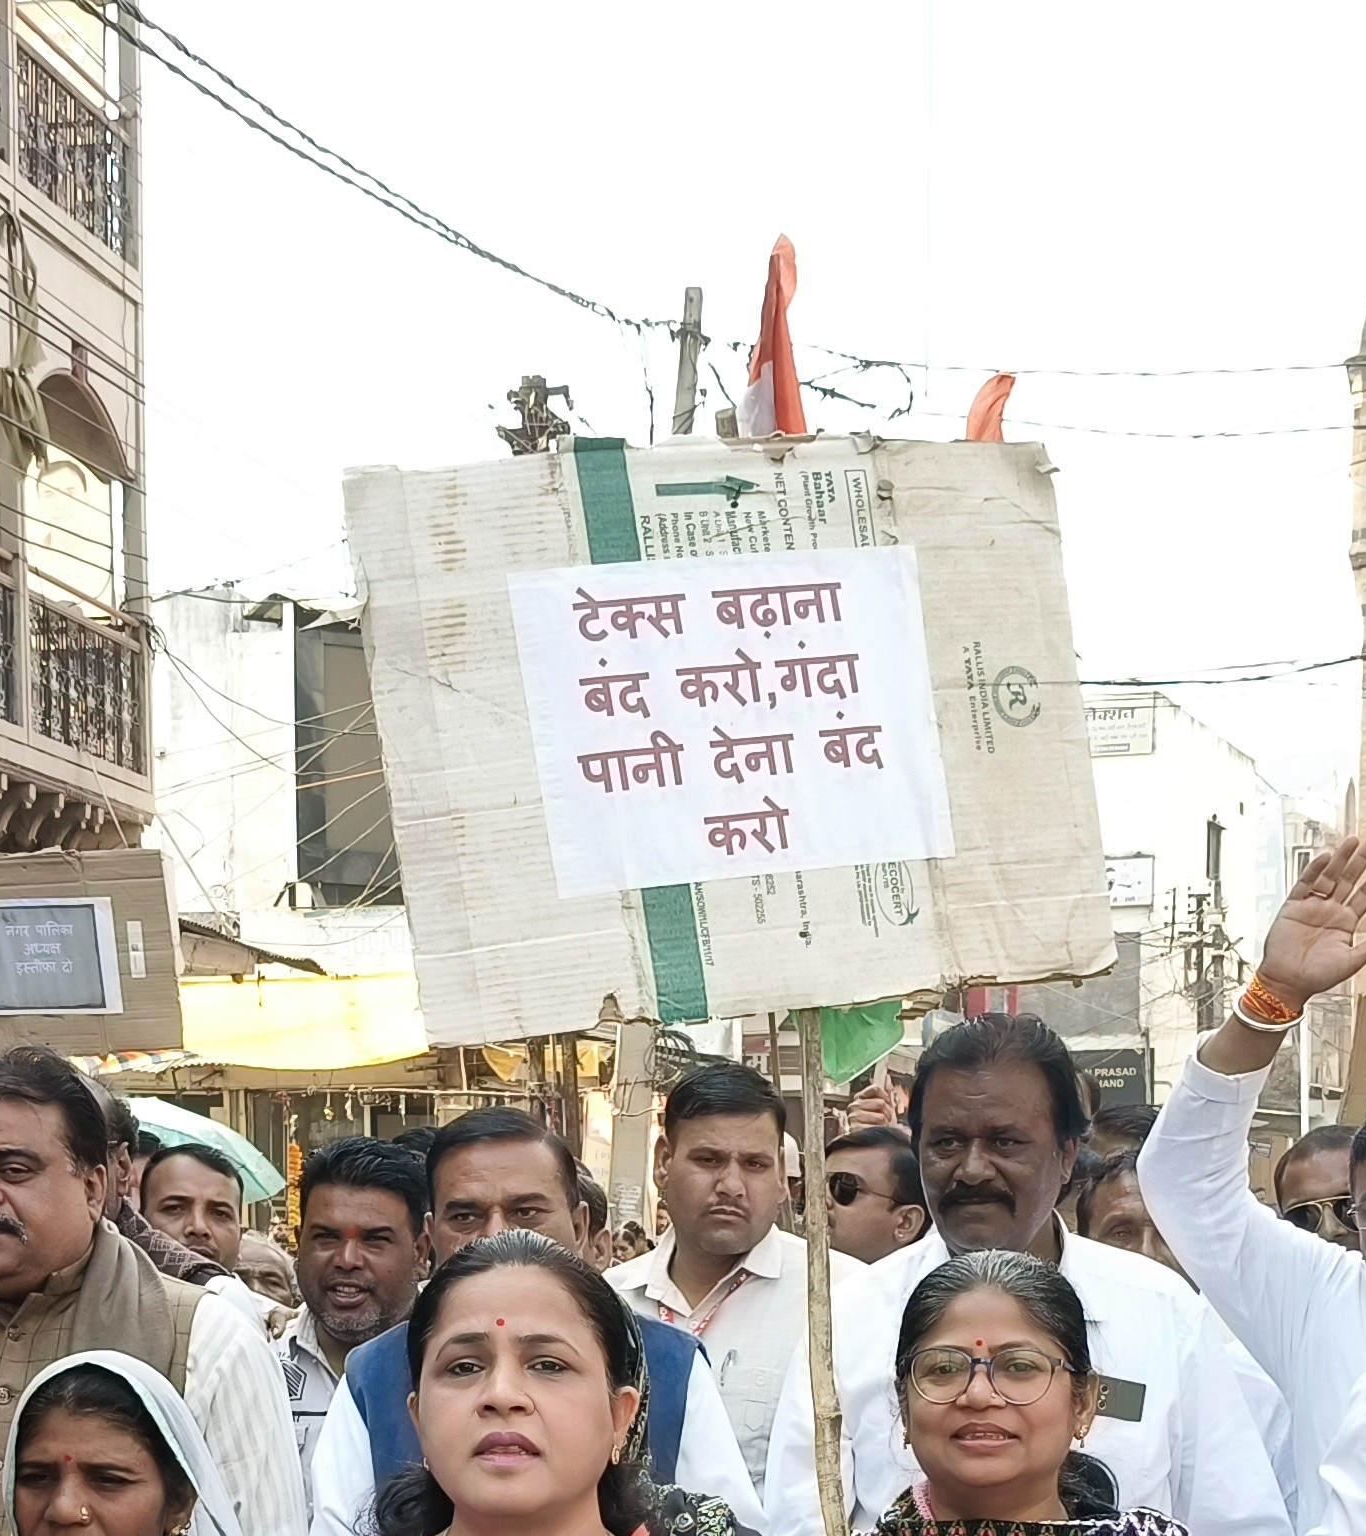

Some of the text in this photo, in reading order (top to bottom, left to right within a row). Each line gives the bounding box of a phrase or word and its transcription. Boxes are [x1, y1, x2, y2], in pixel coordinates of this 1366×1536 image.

[773, 472, 787, 496] NET
[812, 471, 827, 525] Bahaar
[824, 470, 836, 504] TATA
[572, 581, 842, 643] टेक्स बढ़ाना
[579, 658, 652, 719] बंद
[964, 657, 975, 691] TATA
[973, 641, 996, 754] RALLIS INDIA LIMITED
[577, 710, 885, 795] पानी देना बंद
[704, 795, 790, 858] करो
[887, 862, 903, 916] ECOCERT
[4, 920, 74, 938] नगर पालिका
[61, 958, 74, 973] दो
[1094, 1067, 1137, 1077] PRASAD
